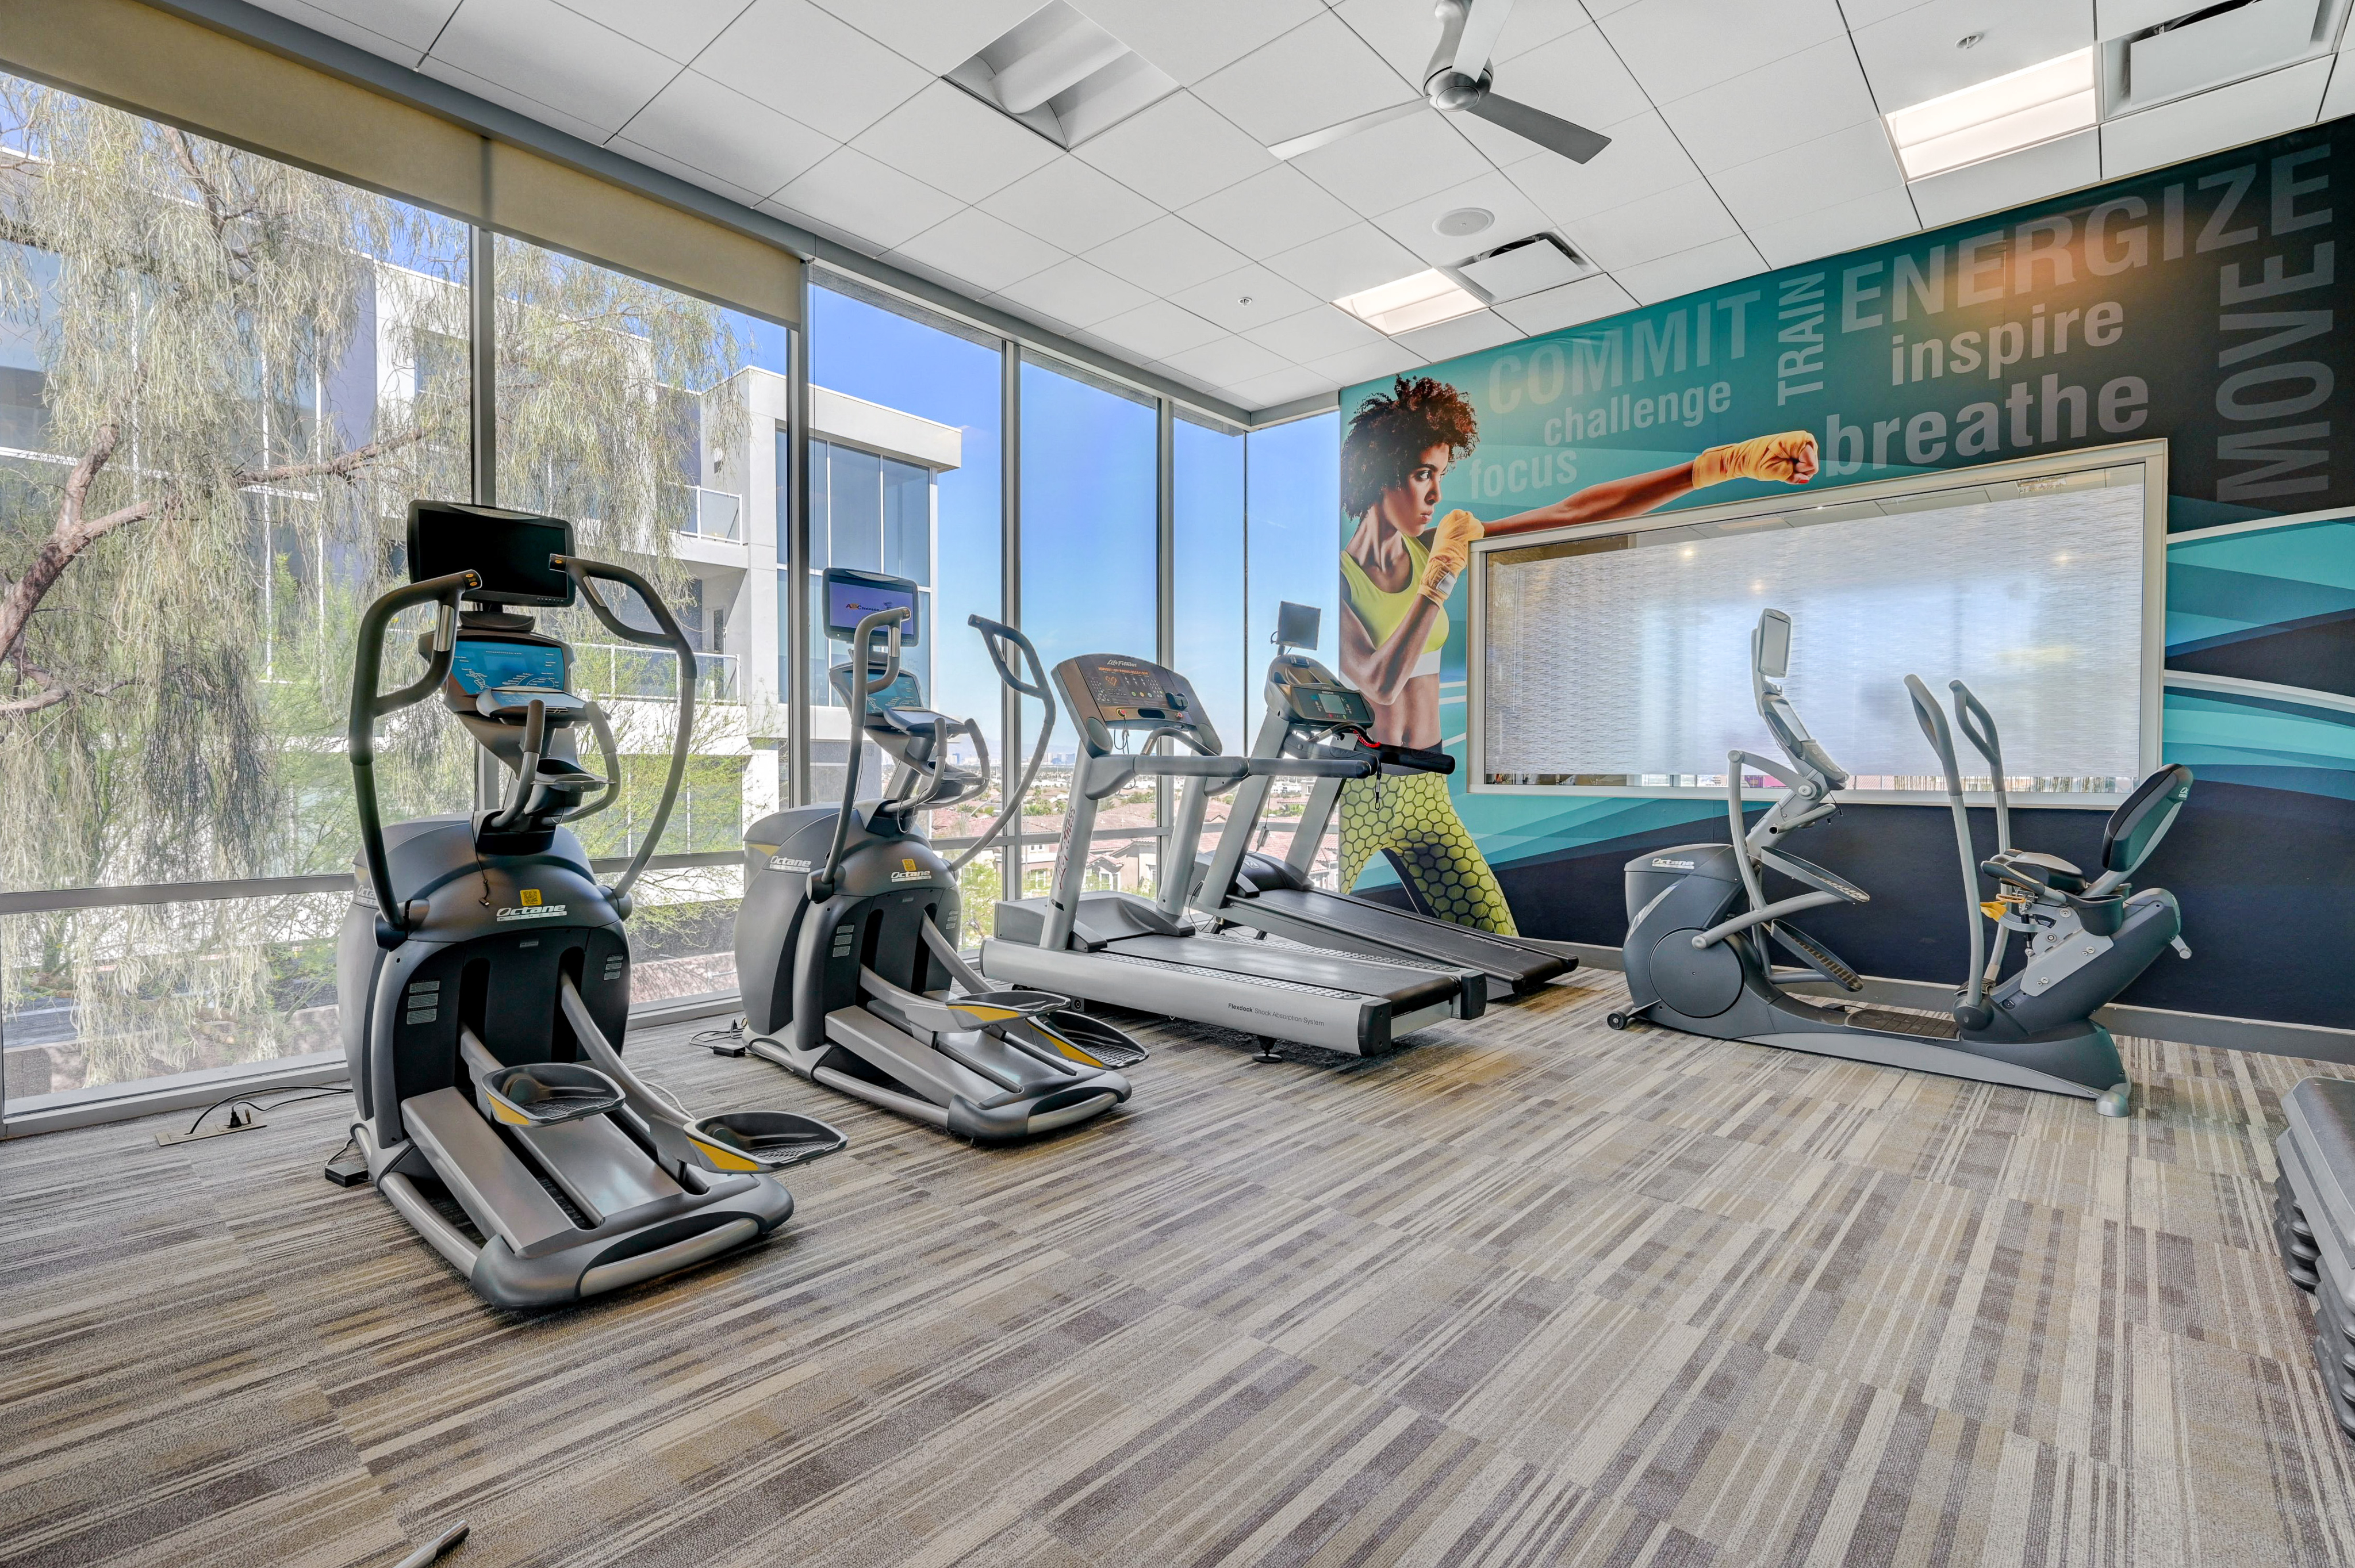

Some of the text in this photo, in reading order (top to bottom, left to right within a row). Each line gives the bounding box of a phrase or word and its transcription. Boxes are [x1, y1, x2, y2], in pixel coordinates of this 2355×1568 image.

[1842, 143, 2332, 334] ENERGIZE
[1489, 290, 1761, 414] COMMIT
[1777, 272, 1825, 406] TRAIN
[1892, 301, 2124, 386] inspire
[2215, 239, 2335, 503] MOVE
[1544, 381, 1731, 447] challenge
[1825, 373, 2149, 477] breathe
[1470, 451, 1577, 499] focus
[770, 856, 812, 867] Octane
[891, 871, 930, 879] Octane
[357, 884, 375, 898] Octa
[496, 904, 566, 917] Octane
[499, 912, 564, 921] FITNESS
[1228, 1003, 1324, 1026] Flexdeck Shock Absorption System
